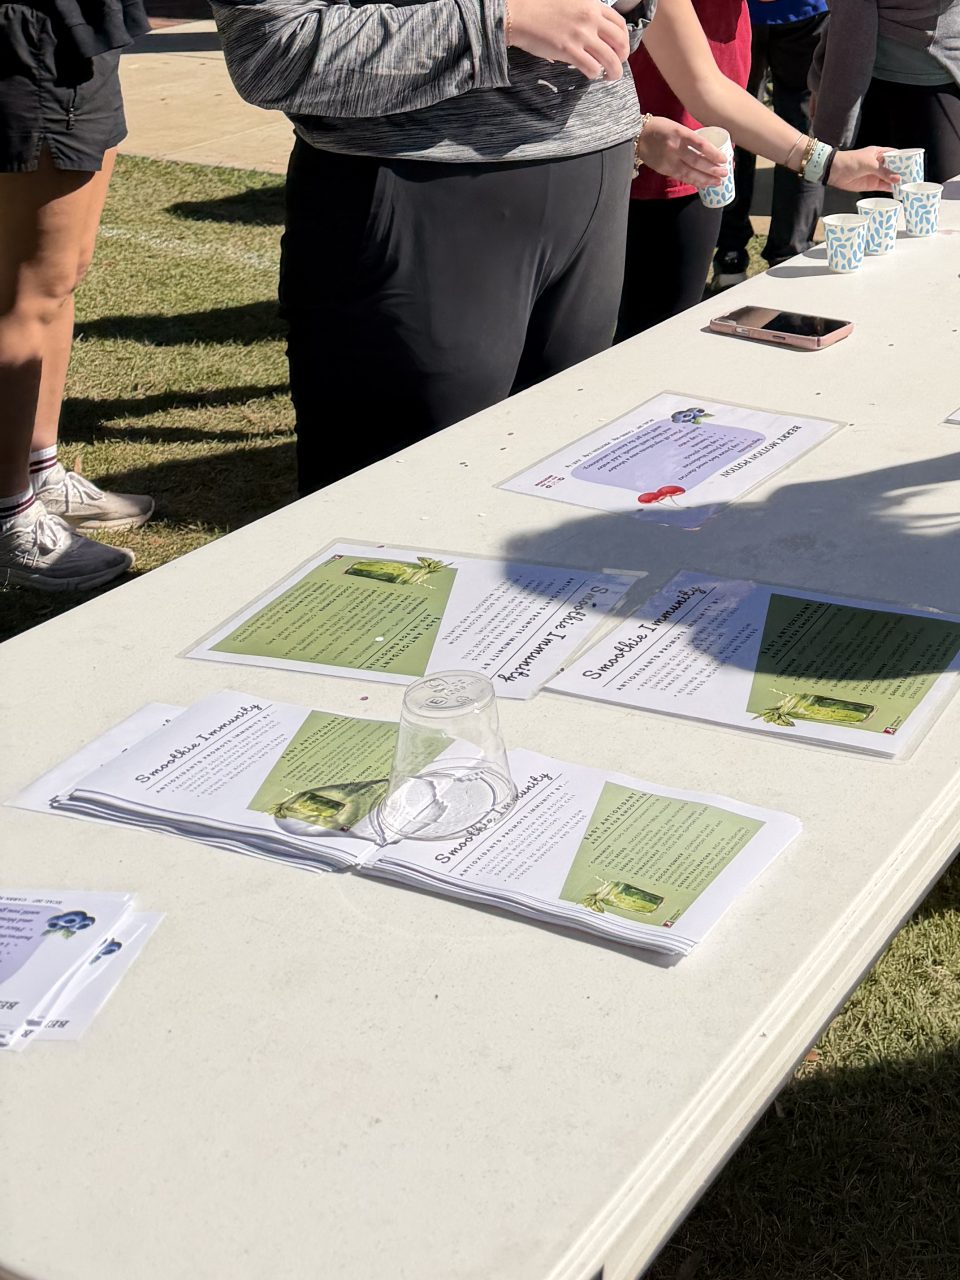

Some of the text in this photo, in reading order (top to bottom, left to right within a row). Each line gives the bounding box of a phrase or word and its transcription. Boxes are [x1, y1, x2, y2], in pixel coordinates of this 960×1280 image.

[720, 425, 801, 477] BERRY MOTION POTION
[555, 587, 607, 629] Smoothie
[583, 587, 706, 679] Smoothie Immunity
[498, 630, 566, 682] Immunity
[135, 743, 200, 783] Smoothie
[196, 705, 261, 741] Immunity
[434, 770, 553, 865] Smoothie Immunity
